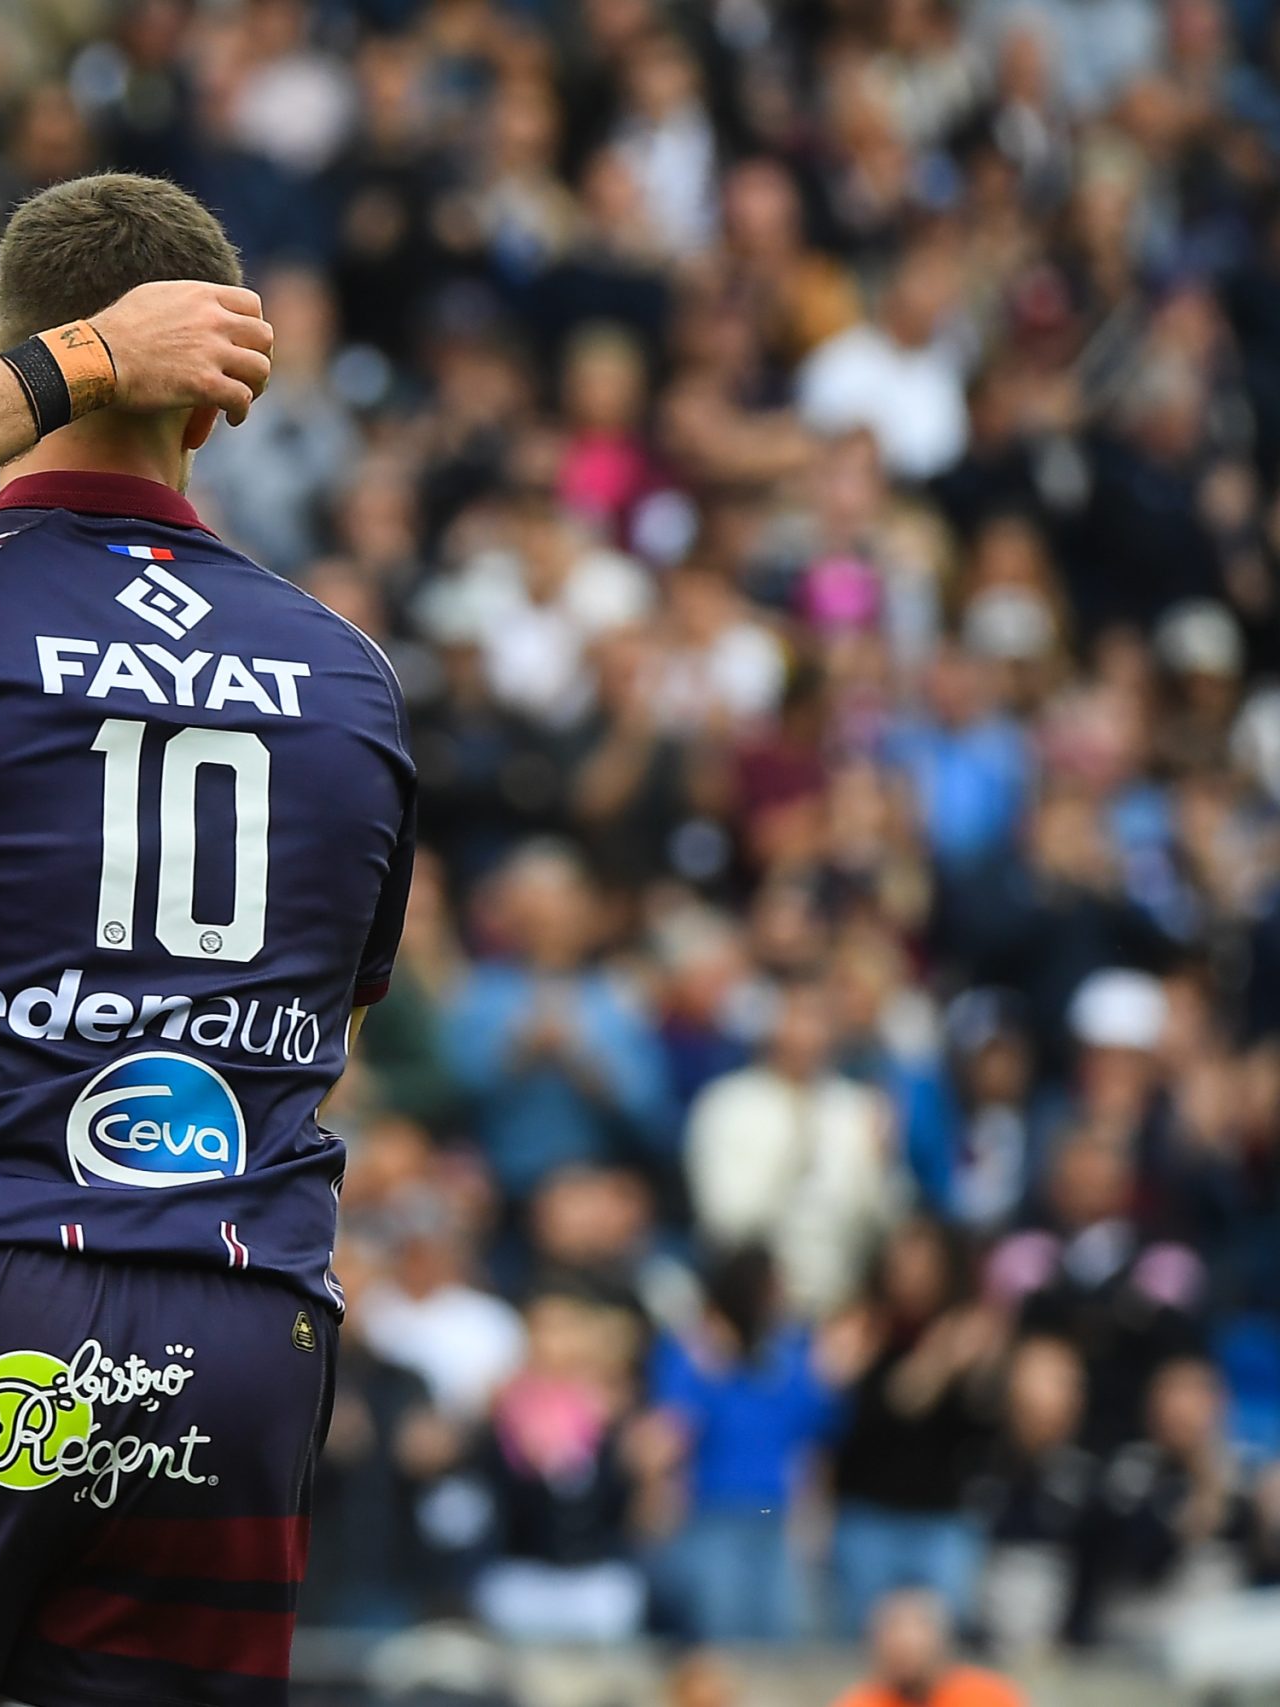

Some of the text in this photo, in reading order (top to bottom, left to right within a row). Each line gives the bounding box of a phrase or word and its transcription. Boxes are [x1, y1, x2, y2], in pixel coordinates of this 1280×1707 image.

[34, 635, 312, 718] FAYAT
[90, 718, 271, 963] 10
[59, 1339, 195, 1405] bistro
